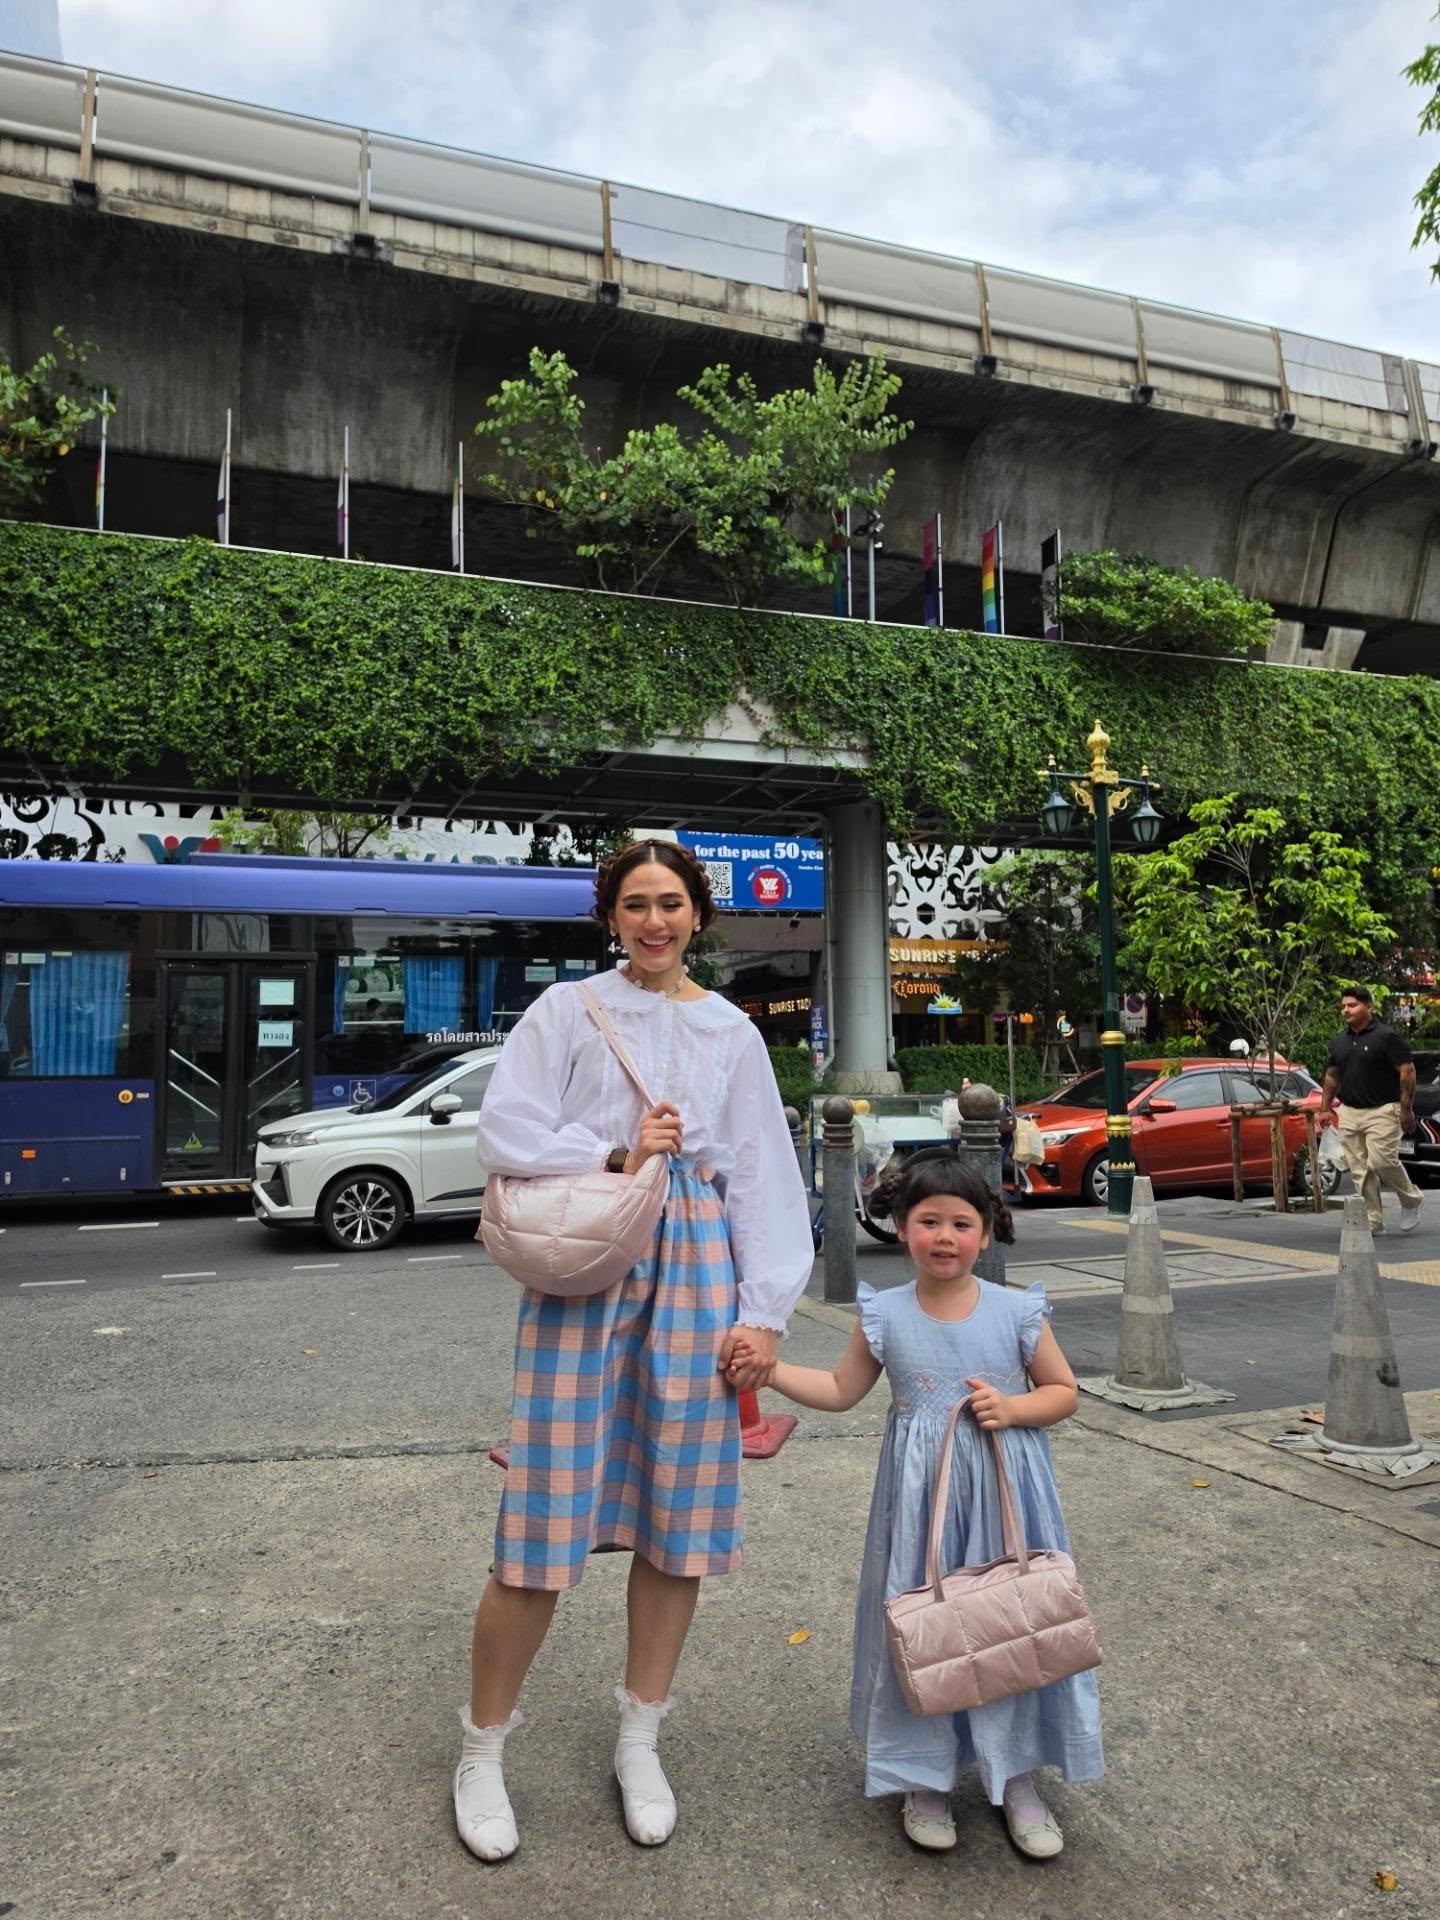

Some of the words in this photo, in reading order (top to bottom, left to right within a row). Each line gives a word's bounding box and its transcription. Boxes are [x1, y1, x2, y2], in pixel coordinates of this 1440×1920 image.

[694, 844, 716, 858] for
[717, 845, 740, 858] the
[741, 847, 771, 861] past
[774, 842, 800, 859] 50
[801, 849, 824, 862] yea
[889, 948, 956, 963] SUNRISE
[893, 979, 941, 998] Corona
[769, 1000, 795, 1015] SUNRISE
